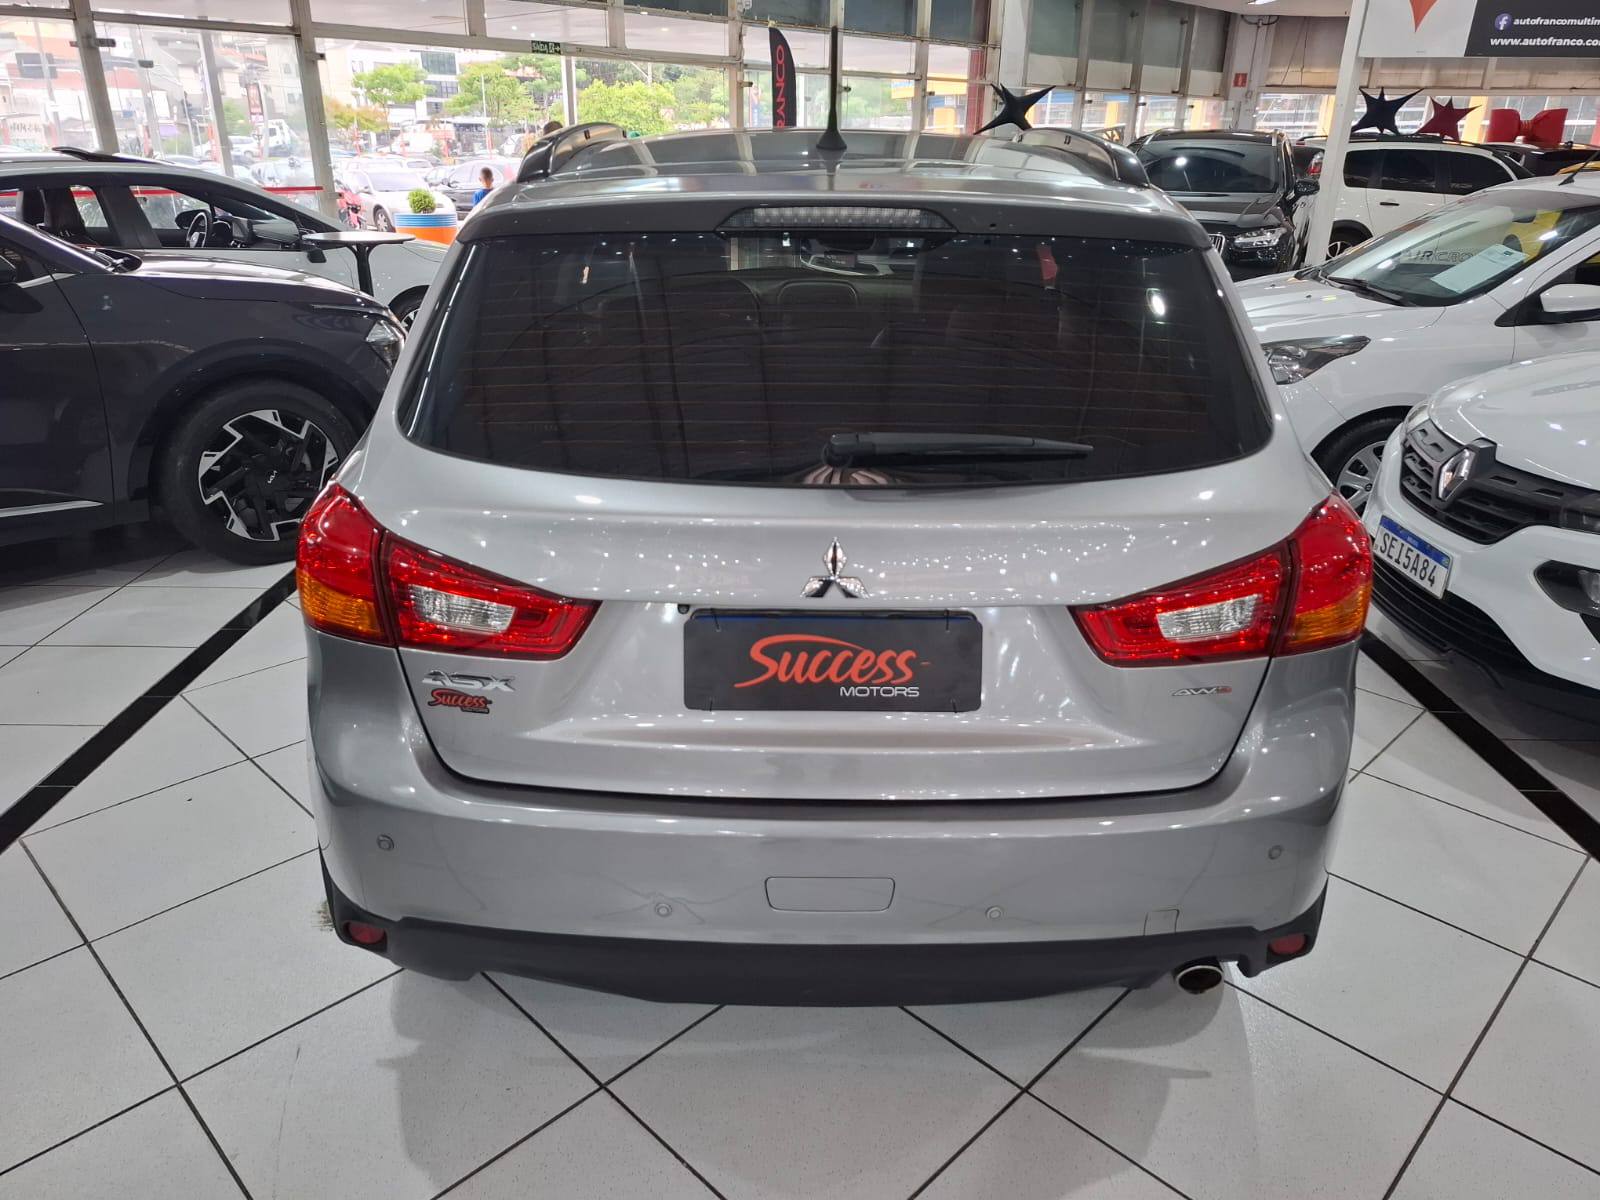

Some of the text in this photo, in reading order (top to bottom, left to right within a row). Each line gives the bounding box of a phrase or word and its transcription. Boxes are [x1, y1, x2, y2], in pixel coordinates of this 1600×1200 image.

[1490, 37, 1600, 46] www.autofranco.co
[1380, 533, 1437, 587] SEI5A84
[734, 633, 918, 688] Success
[428, 688, 488, 708] Success
[840, 686, 919, 697] MOTORS
